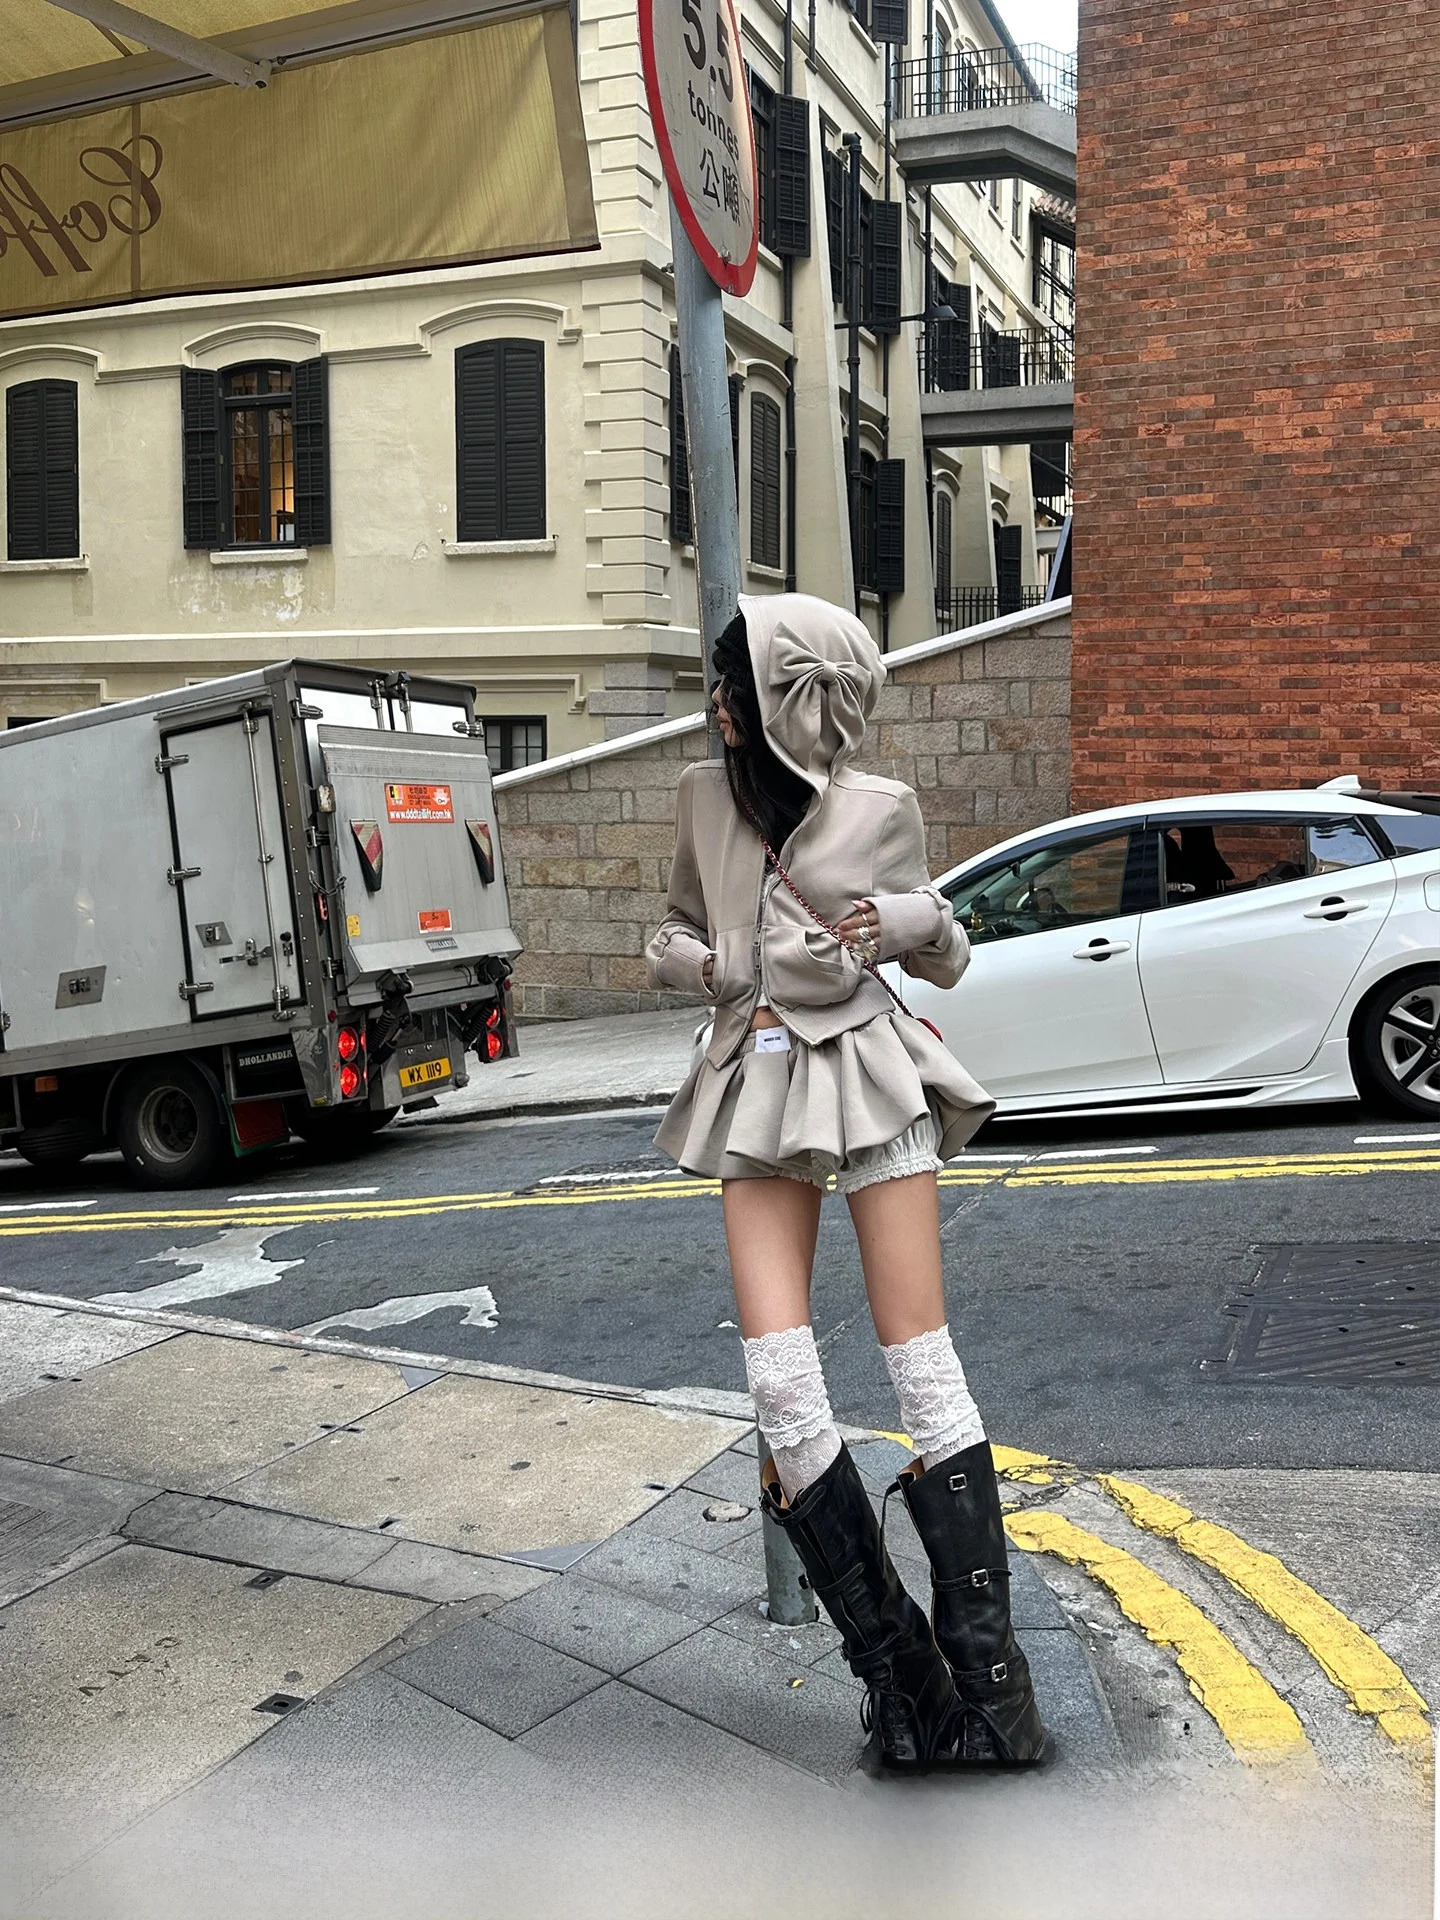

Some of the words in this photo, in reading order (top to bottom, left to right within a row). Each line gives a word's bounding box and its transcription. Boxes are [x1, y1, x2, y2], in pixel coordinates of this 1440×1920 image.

[682, 0, 733, 102] 5.5
[688, 79, 739, 161] tonnes
[699, 147, 740, 227] 公噸
[239, 1049, 293, 1067] DHOLLANDIA
[407, 1066, 423, 1083] WX
[426, 1062, 442, 1079] 1119
